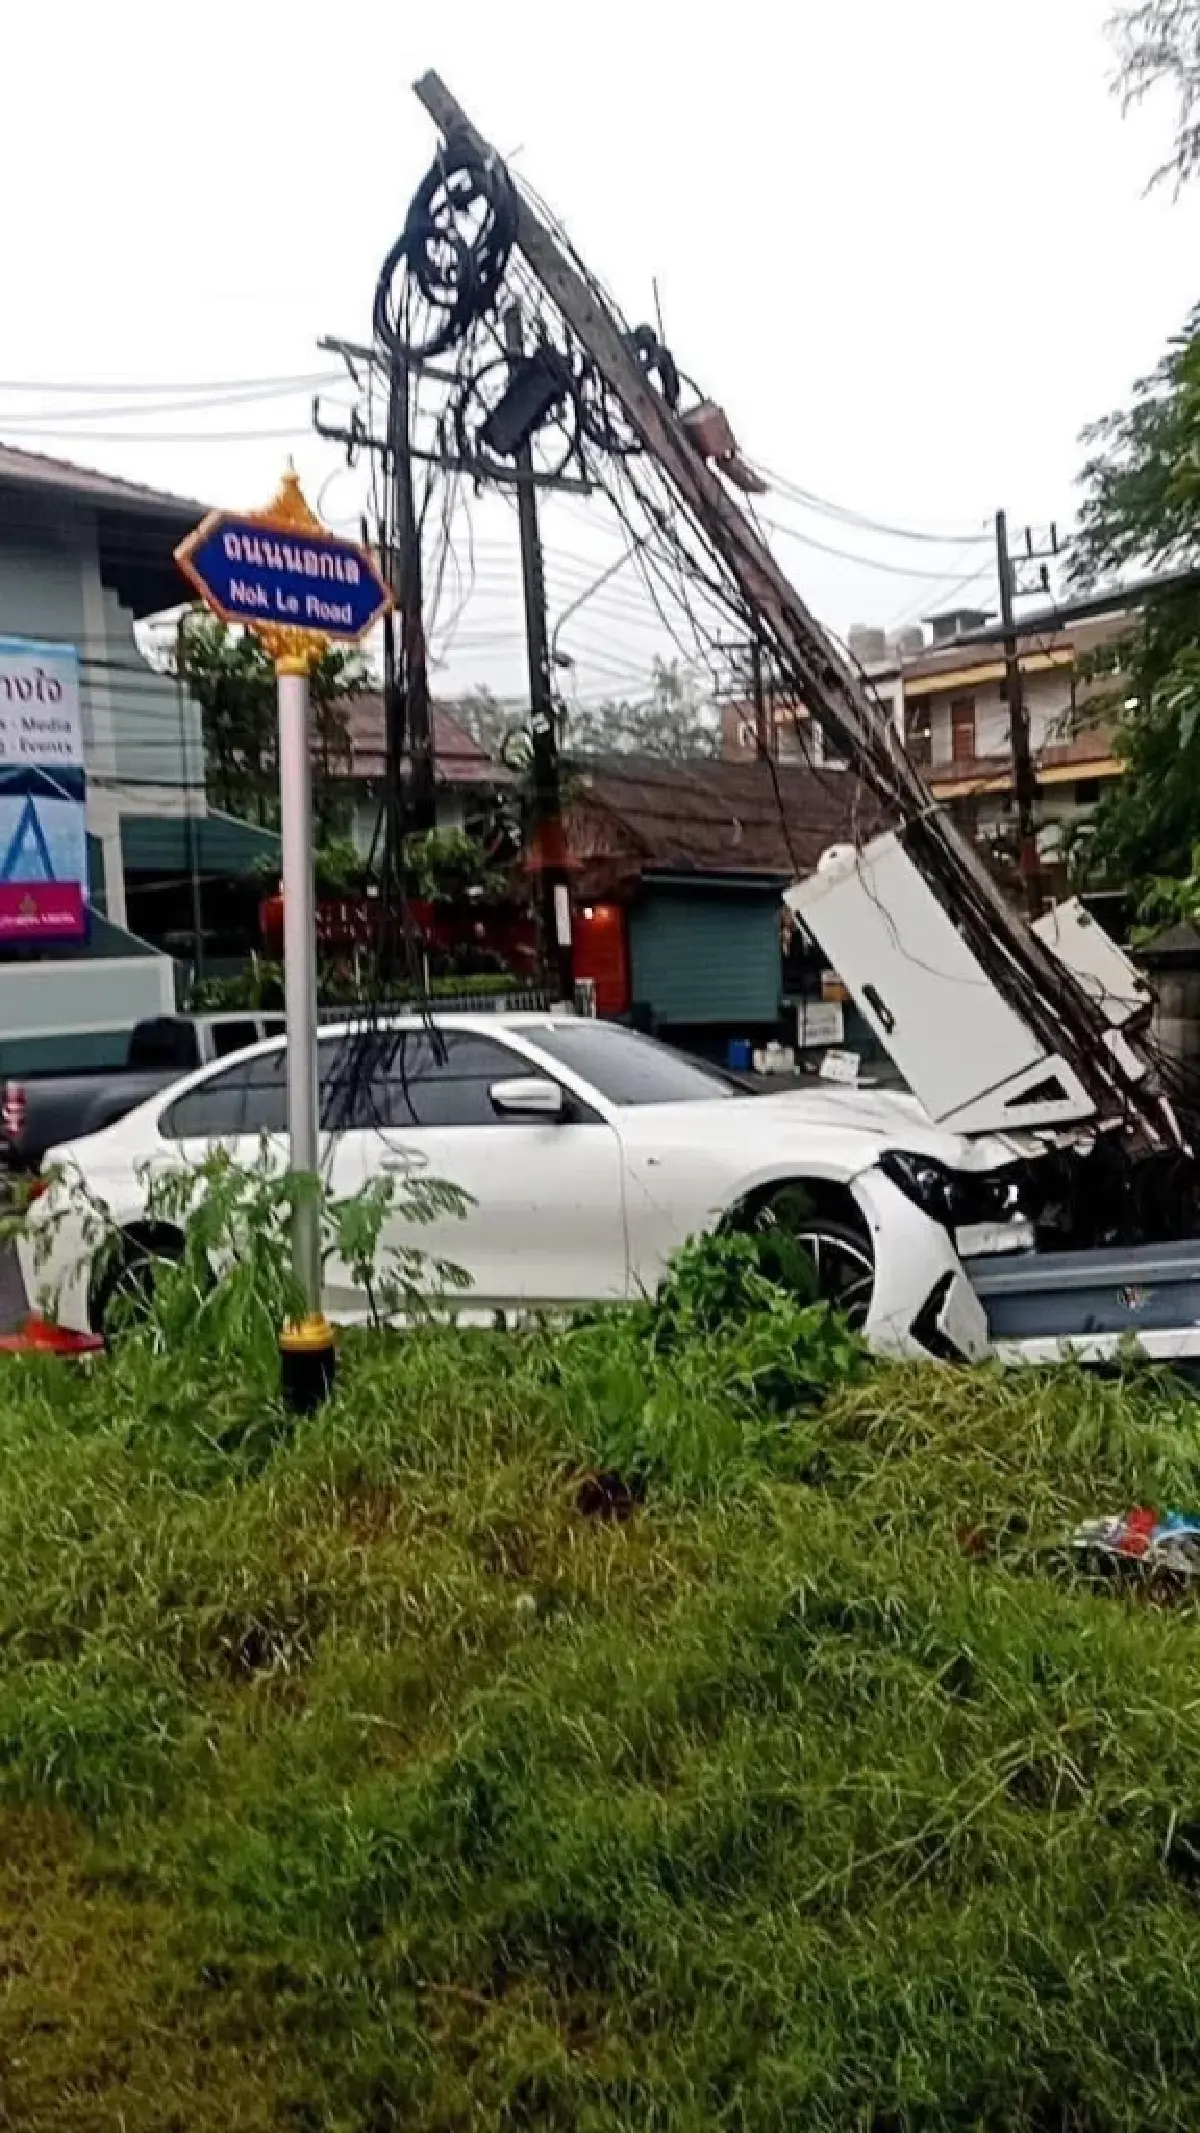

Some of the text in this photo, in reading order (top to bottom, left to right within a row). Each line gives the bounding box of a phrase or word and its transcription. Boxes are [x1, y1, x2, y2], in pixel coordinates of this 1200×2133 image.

[223, 532, 360, 584] ถนนนอกเล
[229, 578, 354, 626] Nok Le Road
